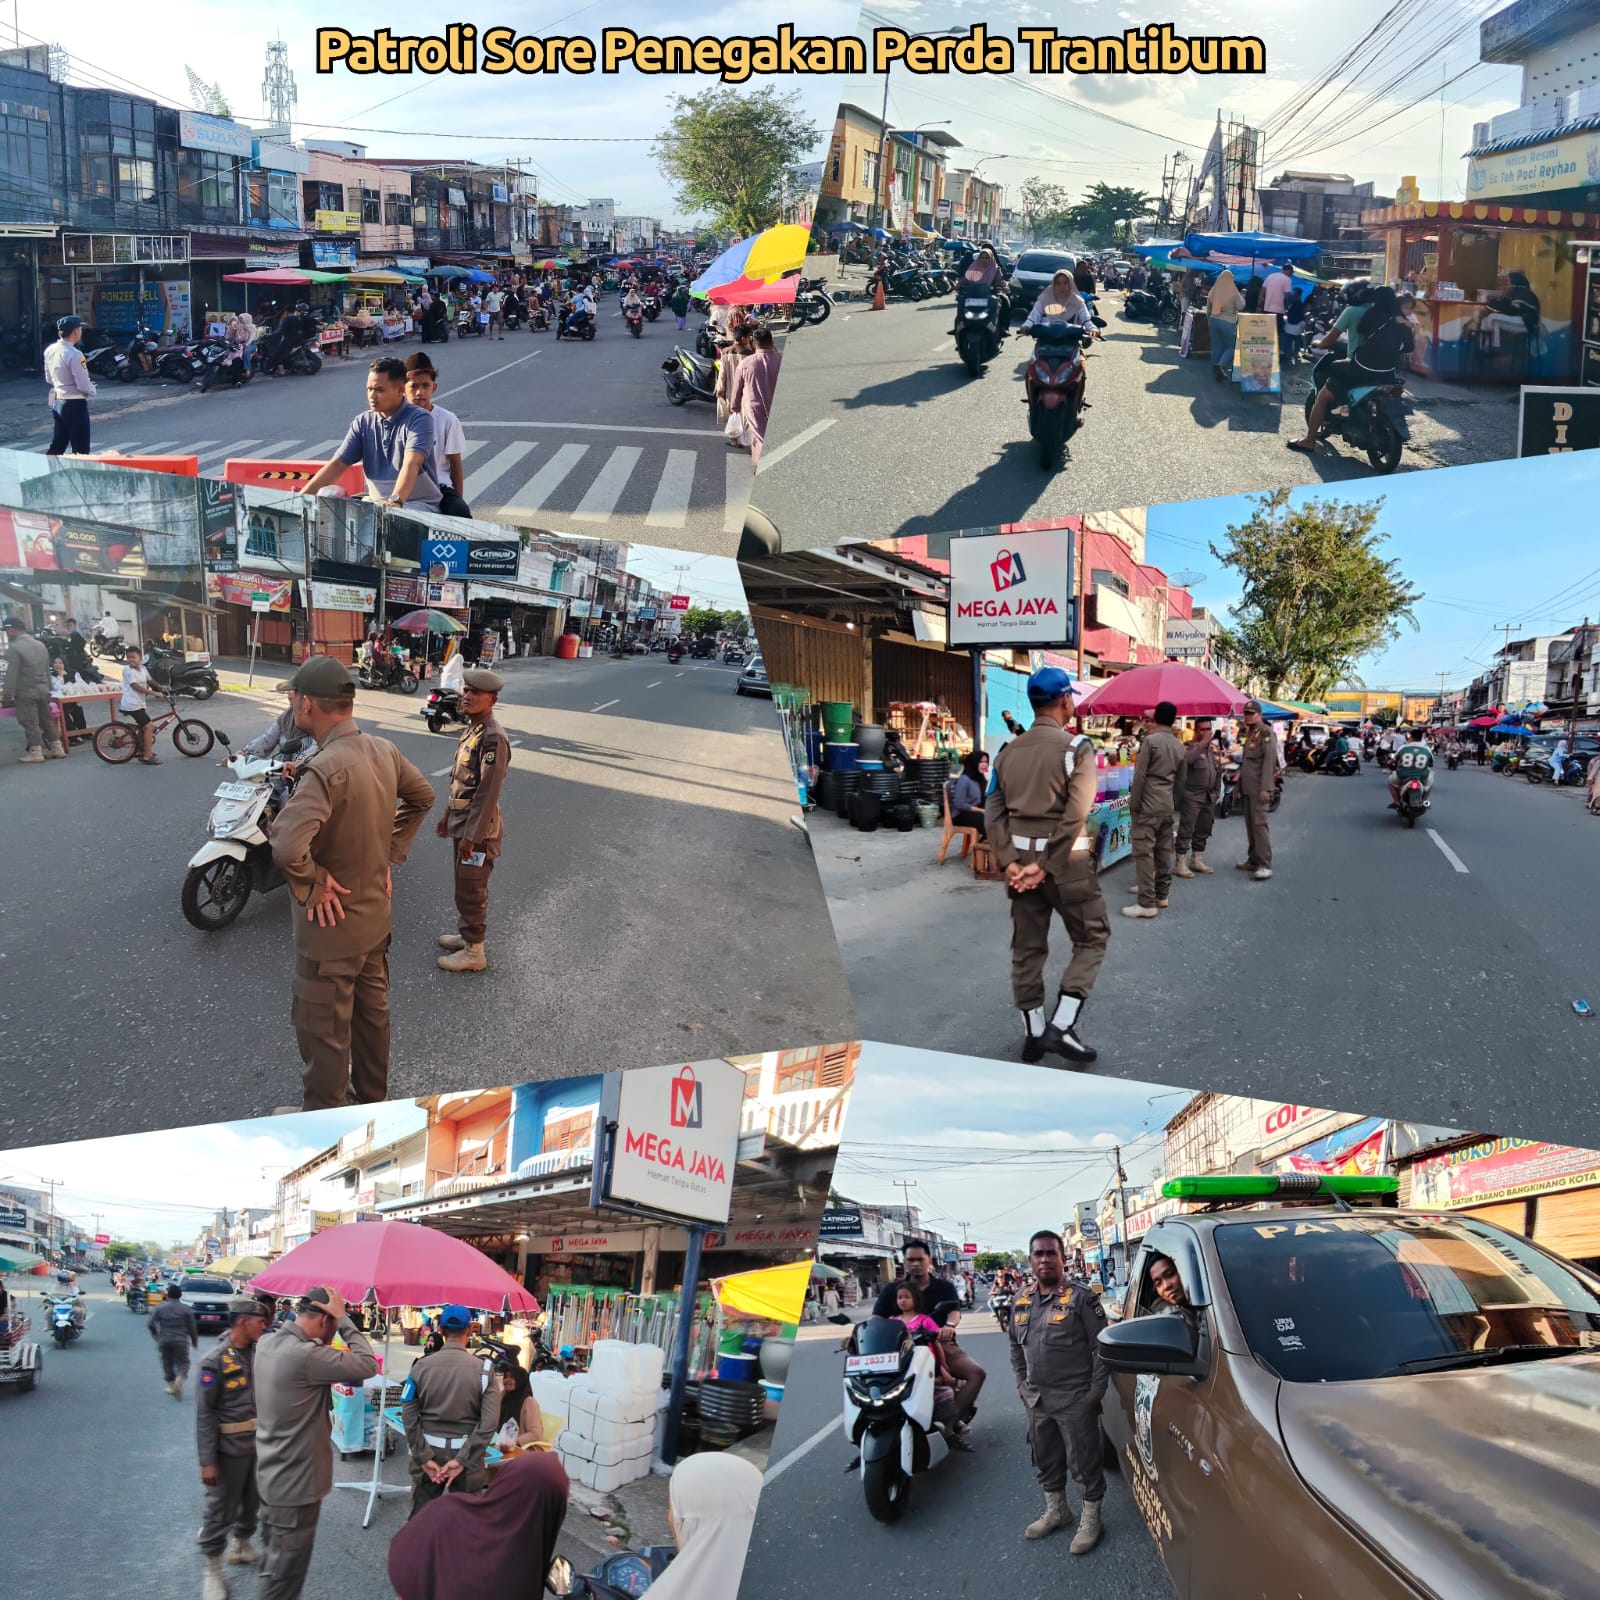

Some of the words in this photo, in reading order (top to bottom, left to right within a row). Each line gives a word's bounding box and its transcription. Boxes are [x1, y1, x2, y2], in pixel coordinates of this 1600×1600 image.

[1531, 147, 1558, 161] Resmi
[1517, 165, 1536, 180] Poci
[1539, 161, 1577, 178] Reyhan
[475, 550, 510, 558] PLATINUM
[672, 599, 689, 607] TCL
[957, 600, 1011, 618] MEGA
[1015, 598, 1058, 615] JAYA
[1165, 647, 1185, 655] DUNIA
[1402, 752, 1428, 769] 88
[625, 1125, 685, 1171] MEGA
[688, 1150, 725, 1184] JAYA
[1449, 1140, 1494, 1166] TOKO
[647, 1169, 669, 1183] Hemat
[671, 1175, 690, 1189] Tanpa
[1452, 1195, 1473, 1206] DATUK
[1475, 1190, 1505, 1202] TABANO
[1507, 1179, 1567, 1196] BANGKINANG
[1569, 1172, 1597, 1184] KOTA
[1126, 1210, 1154, 1235] ZIKRA
[568, 1238, 589, 1247] MEGA
[590, 1236, 608, 1246] JAYA
[734, 1229, 775, 1242] MEGA
[779, 1227, 815, 1241] JAYA
